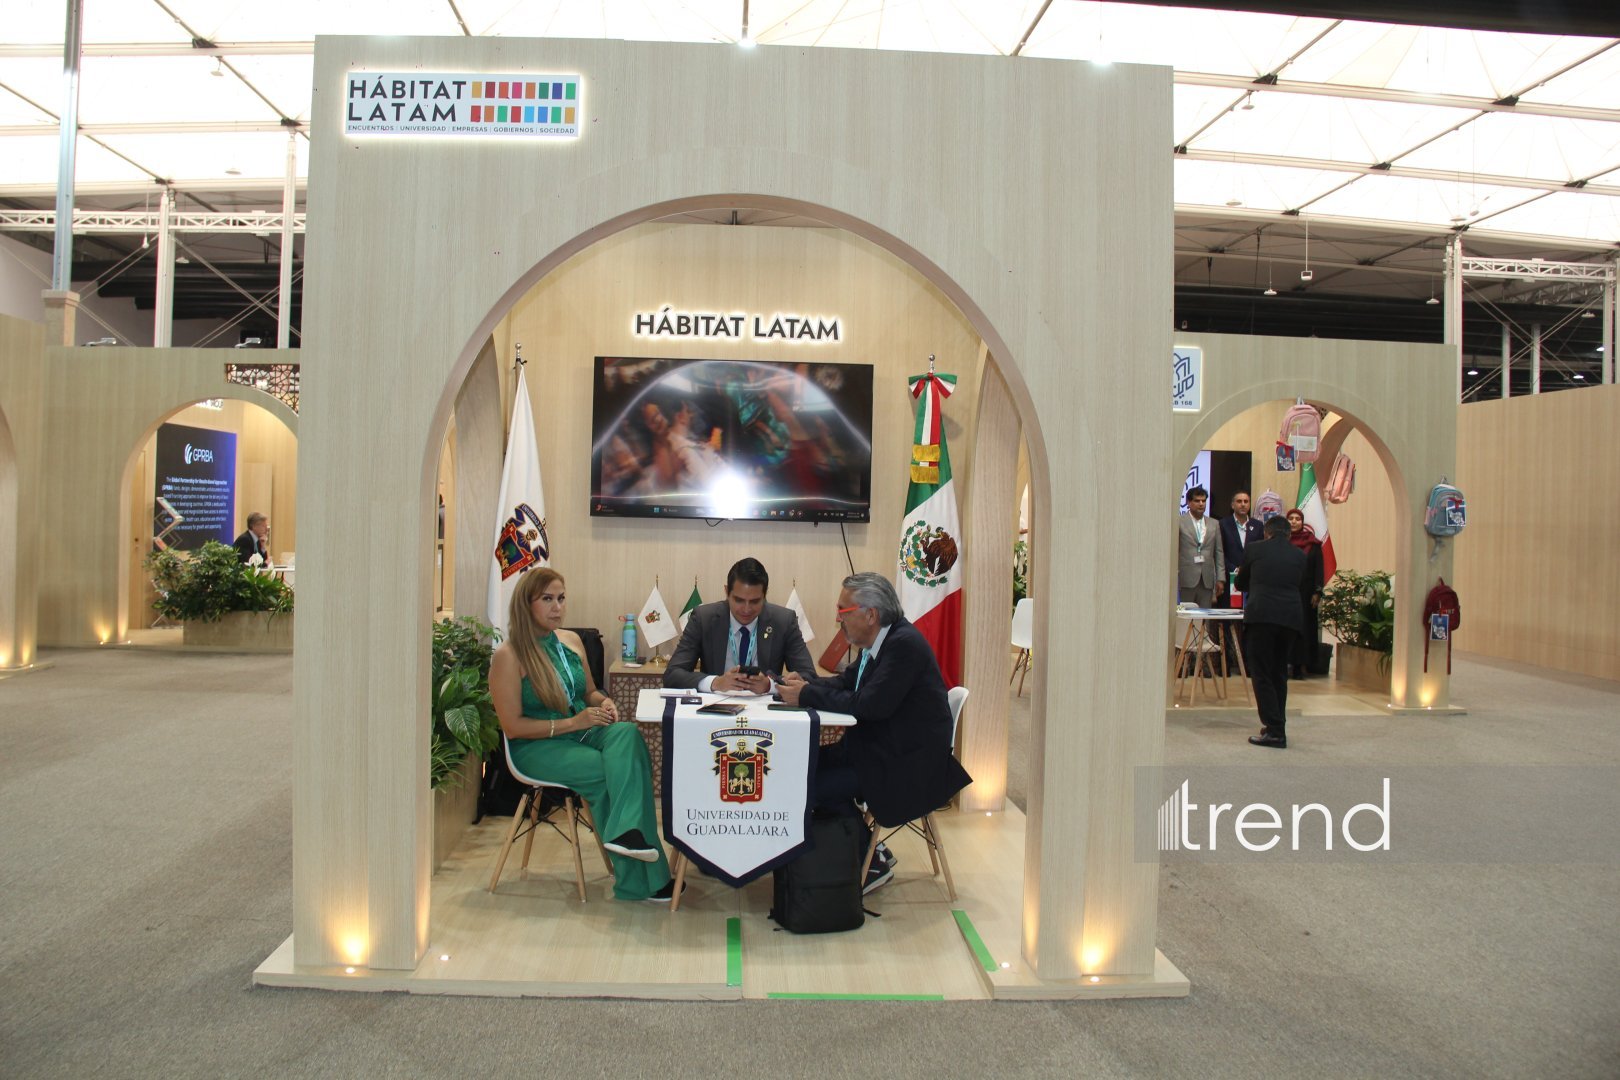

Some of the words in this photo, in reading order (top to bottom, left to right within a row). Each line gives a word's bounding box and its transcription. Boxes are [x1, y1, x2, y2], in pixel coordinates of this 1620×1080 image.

[350, 75, 467, 100] HÁBITAT
[348, 102, 456, 122] LATAM
[493, 126, 534, 134] GOBIERNOS
[636, 307, 745, 337] HÁBITAT
[754, 317, 839, 341] LATAM
[193, 448, 213, 463] GPRBA
[687, 808, 771, 821] UNIVERSIDAD
[773, 811, 789, 821] DE
[686, 823, 789, 837] GUADALAJARA
